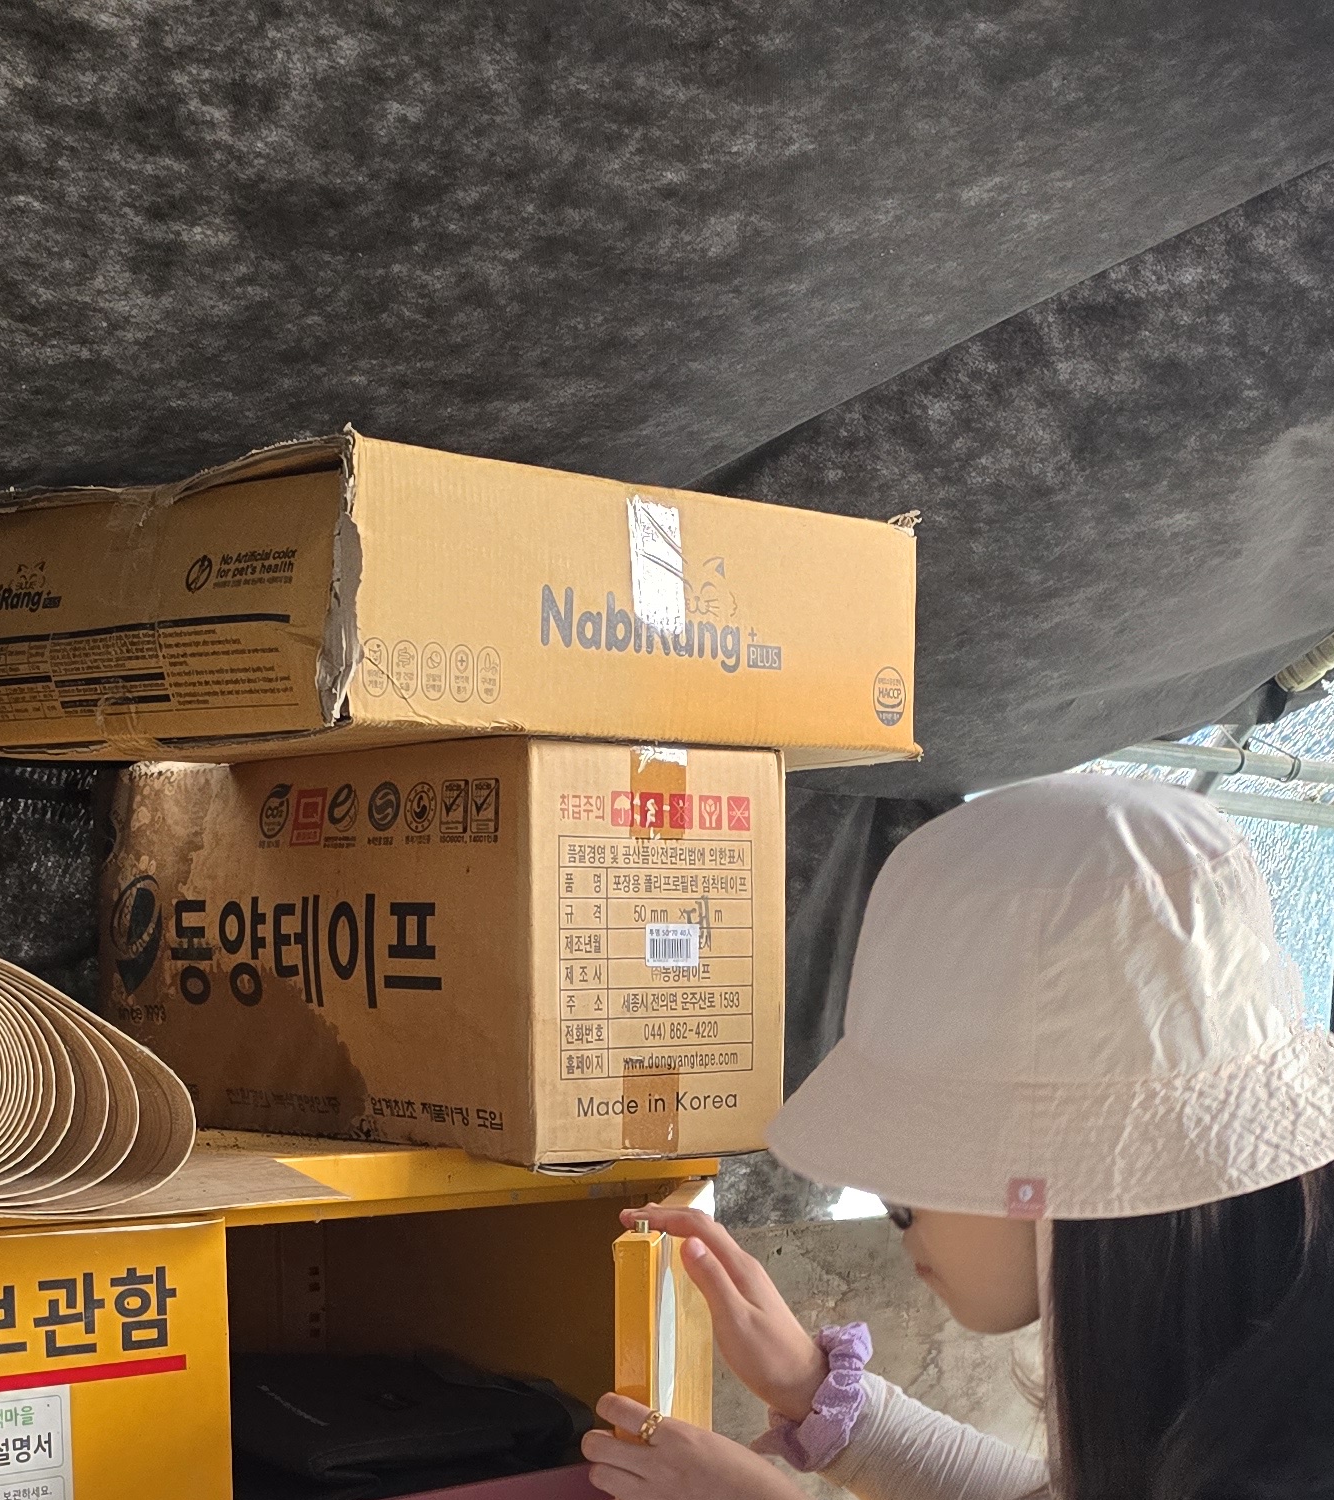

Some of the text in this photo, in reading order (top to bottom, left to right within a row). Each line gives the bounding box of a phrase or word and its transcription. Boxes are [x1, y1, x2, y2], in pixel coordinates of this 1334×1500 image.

[259, 561, 293, 574] health
[749, 648, 780, 669] PLUS
[878, 687, 901, 699] HACCP
[560, 794, 605, 820] 취급주의
[568, 844, 744, 866] 품질경영 및 공산품안전관리법에 의한표시
[614, 875, 747, 893] 포장용 폴리프로필렌 점착테이프
[633, 905, 667, 922] 50 mm
[171, 893, 442, 1008] 동양테이프
[565, 934, 601, 953] 제조년월
[622, 992, 740, 1012] 세종시 전의면 운주산로 1593
[565, 1023, 604, 1044] 전화번호
[644, 1021, 718, 1040] 044) 862-4220
[566, 1055, 603, 1074] 홈페이지
[623, 1051, 738, 1070] www.dongyangtape.com
[577, 1092, 737, 1117] Made in Korea
[476, 1108, 504, 1130] 도입
